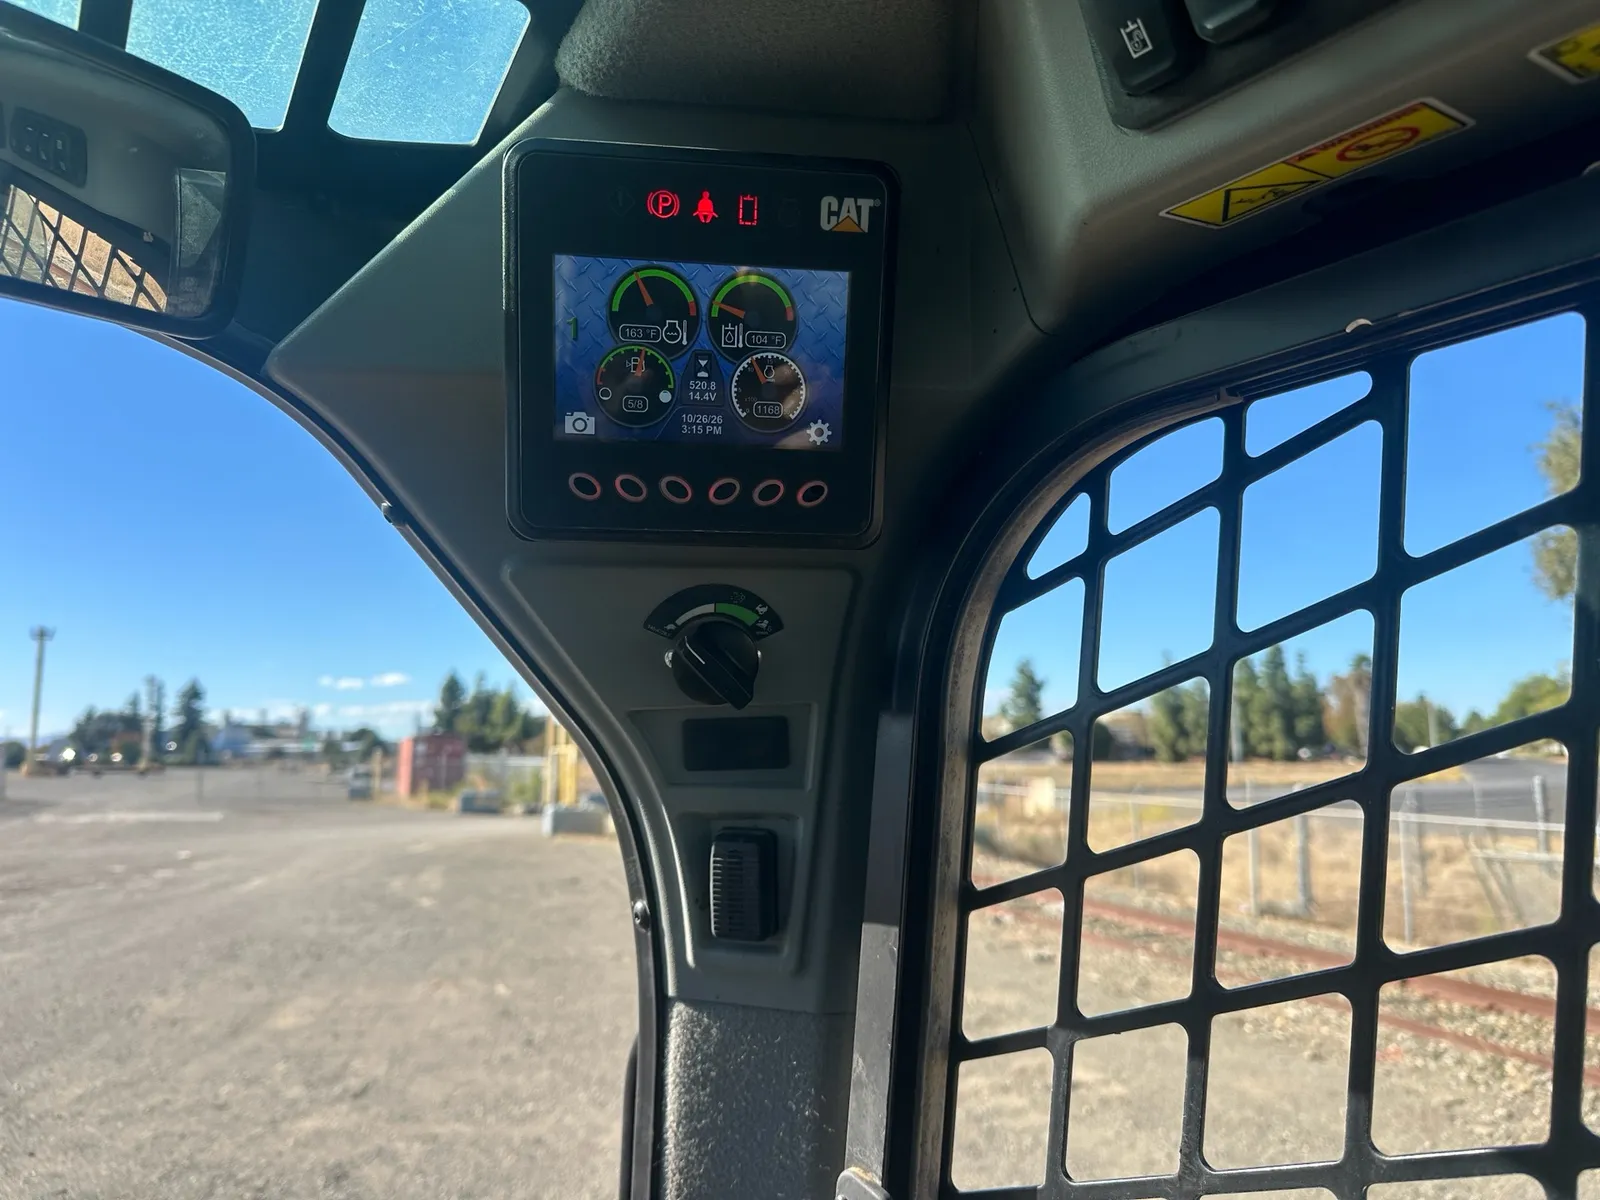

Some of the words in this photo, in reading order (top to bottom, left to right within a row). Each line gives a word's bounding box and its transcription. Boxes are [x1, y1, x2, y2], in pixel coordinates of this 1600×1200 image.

[566, 317, 578, 340] 1
[625, 328, 643, 338] 163
[751, 334, 768, 344] 104
[689, 380, 716, 391] 520.8
[689, 392, 717, 402] 14.4V
[627, 399, 644, 409] 5/8
[757, 405, 780, 415] 1168
[681, 414, 723, 425] 10/26/26
[681, 425, 703, 435] 3:15
[706, 426, 722, 436] PM
